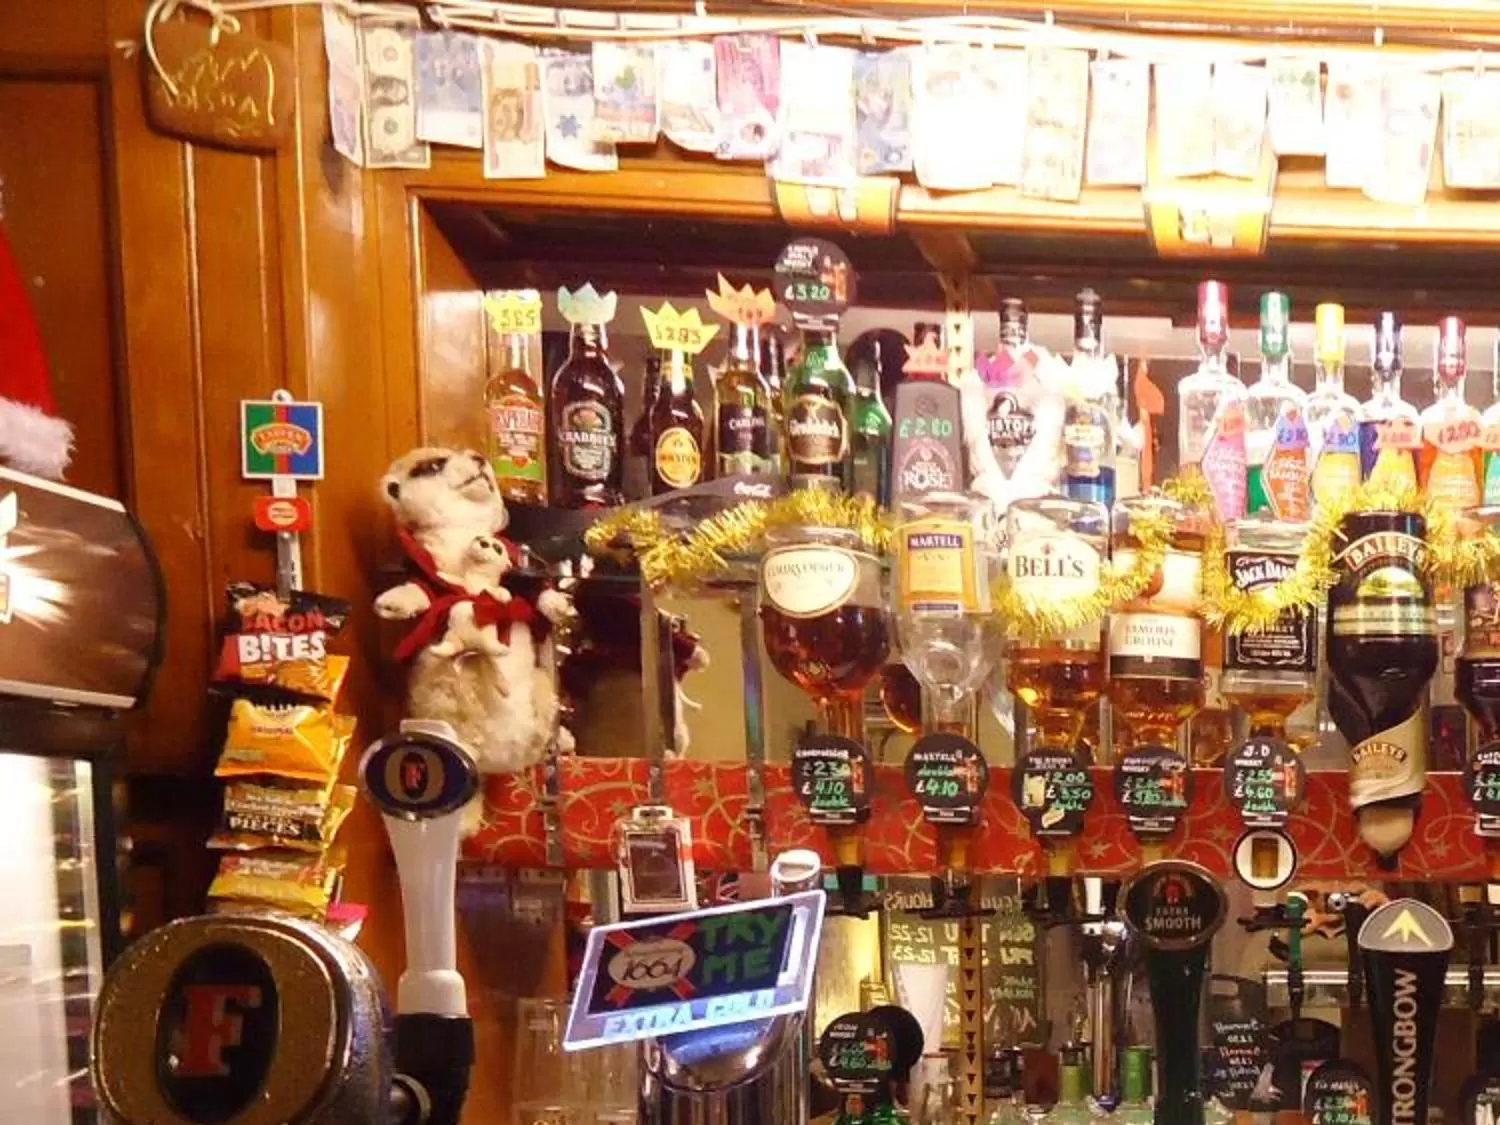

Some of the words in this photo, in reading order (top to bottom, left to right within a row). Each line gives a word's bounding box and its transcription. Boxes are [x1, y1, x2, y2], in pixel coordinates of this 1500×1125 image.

[910, 535, 960, 548] MARTELL
[1350, 536, 1427, 566] BAILEYS
[1015, 554, 1085, 578] BELL'S
[1352, 743, 1406, 762] BAILEYS
[229, 815, 302, 836] PIECES
[700, 910, 782, 949] TRY
[1145, 915, 1201, 930] SMOOTH
[621, 958, 684, 981] 1664
[703, 951, 770, 984] ME
[175, 983, 261, 1077] F
